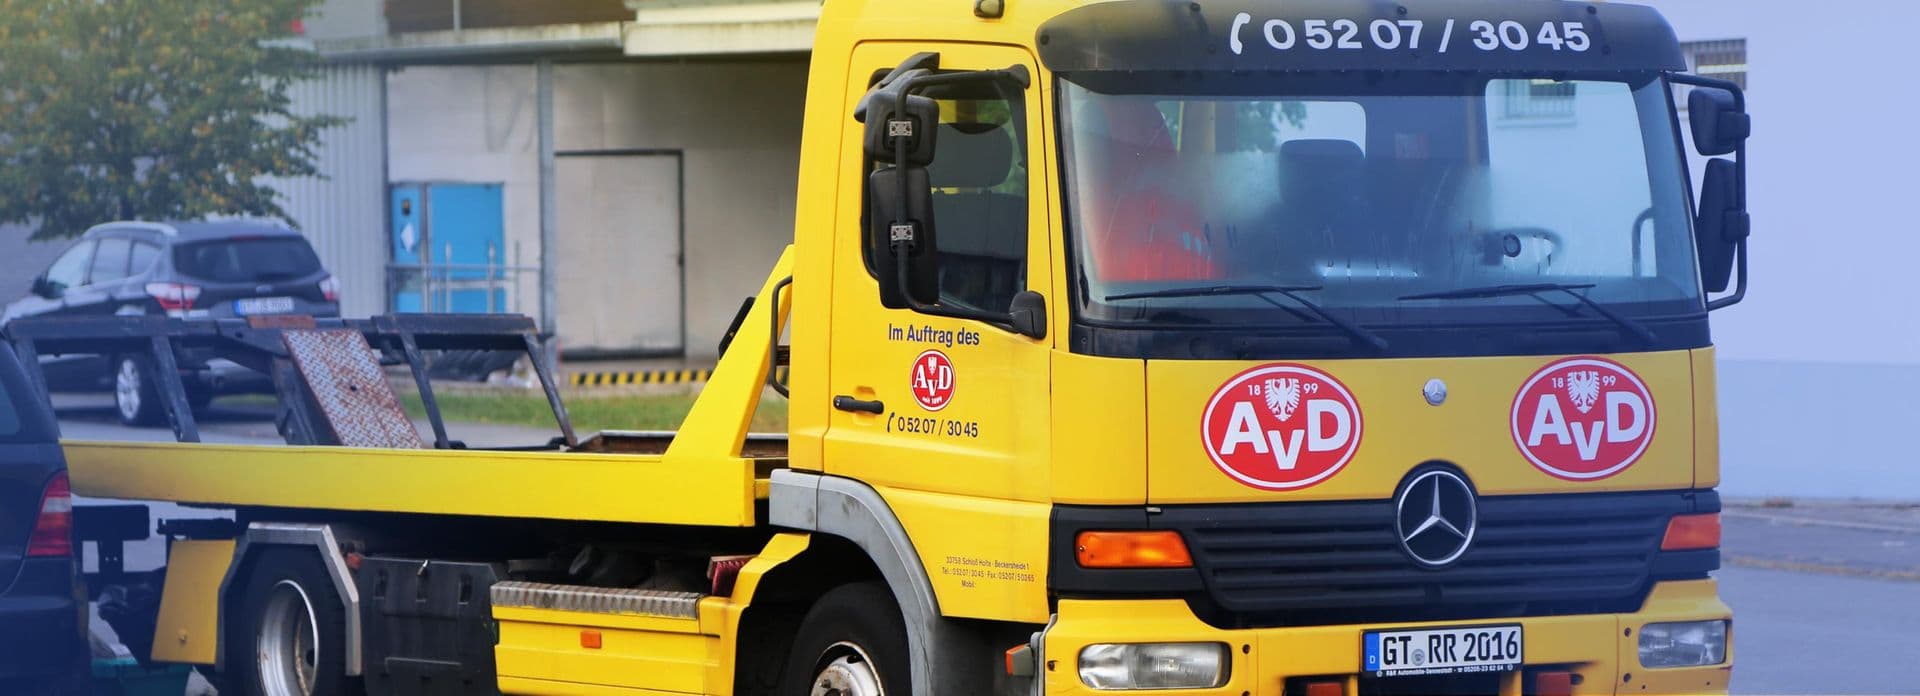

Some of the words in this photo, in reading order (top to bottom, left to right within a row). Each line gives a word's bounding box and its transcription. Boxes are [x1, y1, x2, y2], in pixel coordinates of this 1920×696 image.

[1263, 19, 1295, 50] 0
[1304, 19, 1363, 50] 52
[1369, 19, 1424, 50] 07
[1438, 19, 1454, 53] /
[1470, 20, 1529, 51] 30
[1536, 21, 1591, 52] 45
[889, 323, 903, 340] Im
[907, 324, 953, 348] Auftrag
[957, 327, 980, 345] des
[1248, 384, 1261, 396] 18
[1303, 383, 1319, 394] 99
[1552, 377, 1564, 388] 18
[1602, 375, 1616, 386] 99
[898, 416, 905, 432] 0
[907, 417, 920, 433] 52
[922, 418, 936, 434] 07
[938, 419, 945, 436] /
[947, 420, 962, 436] 30
[964, 421, 978, 438] 45
[1383, 635, 1412, 666] GT
[1428, 633, 1457, 663] RR
[1463, 630, 1518, 662] 2016
[1369, 655, 1376, 664] D
